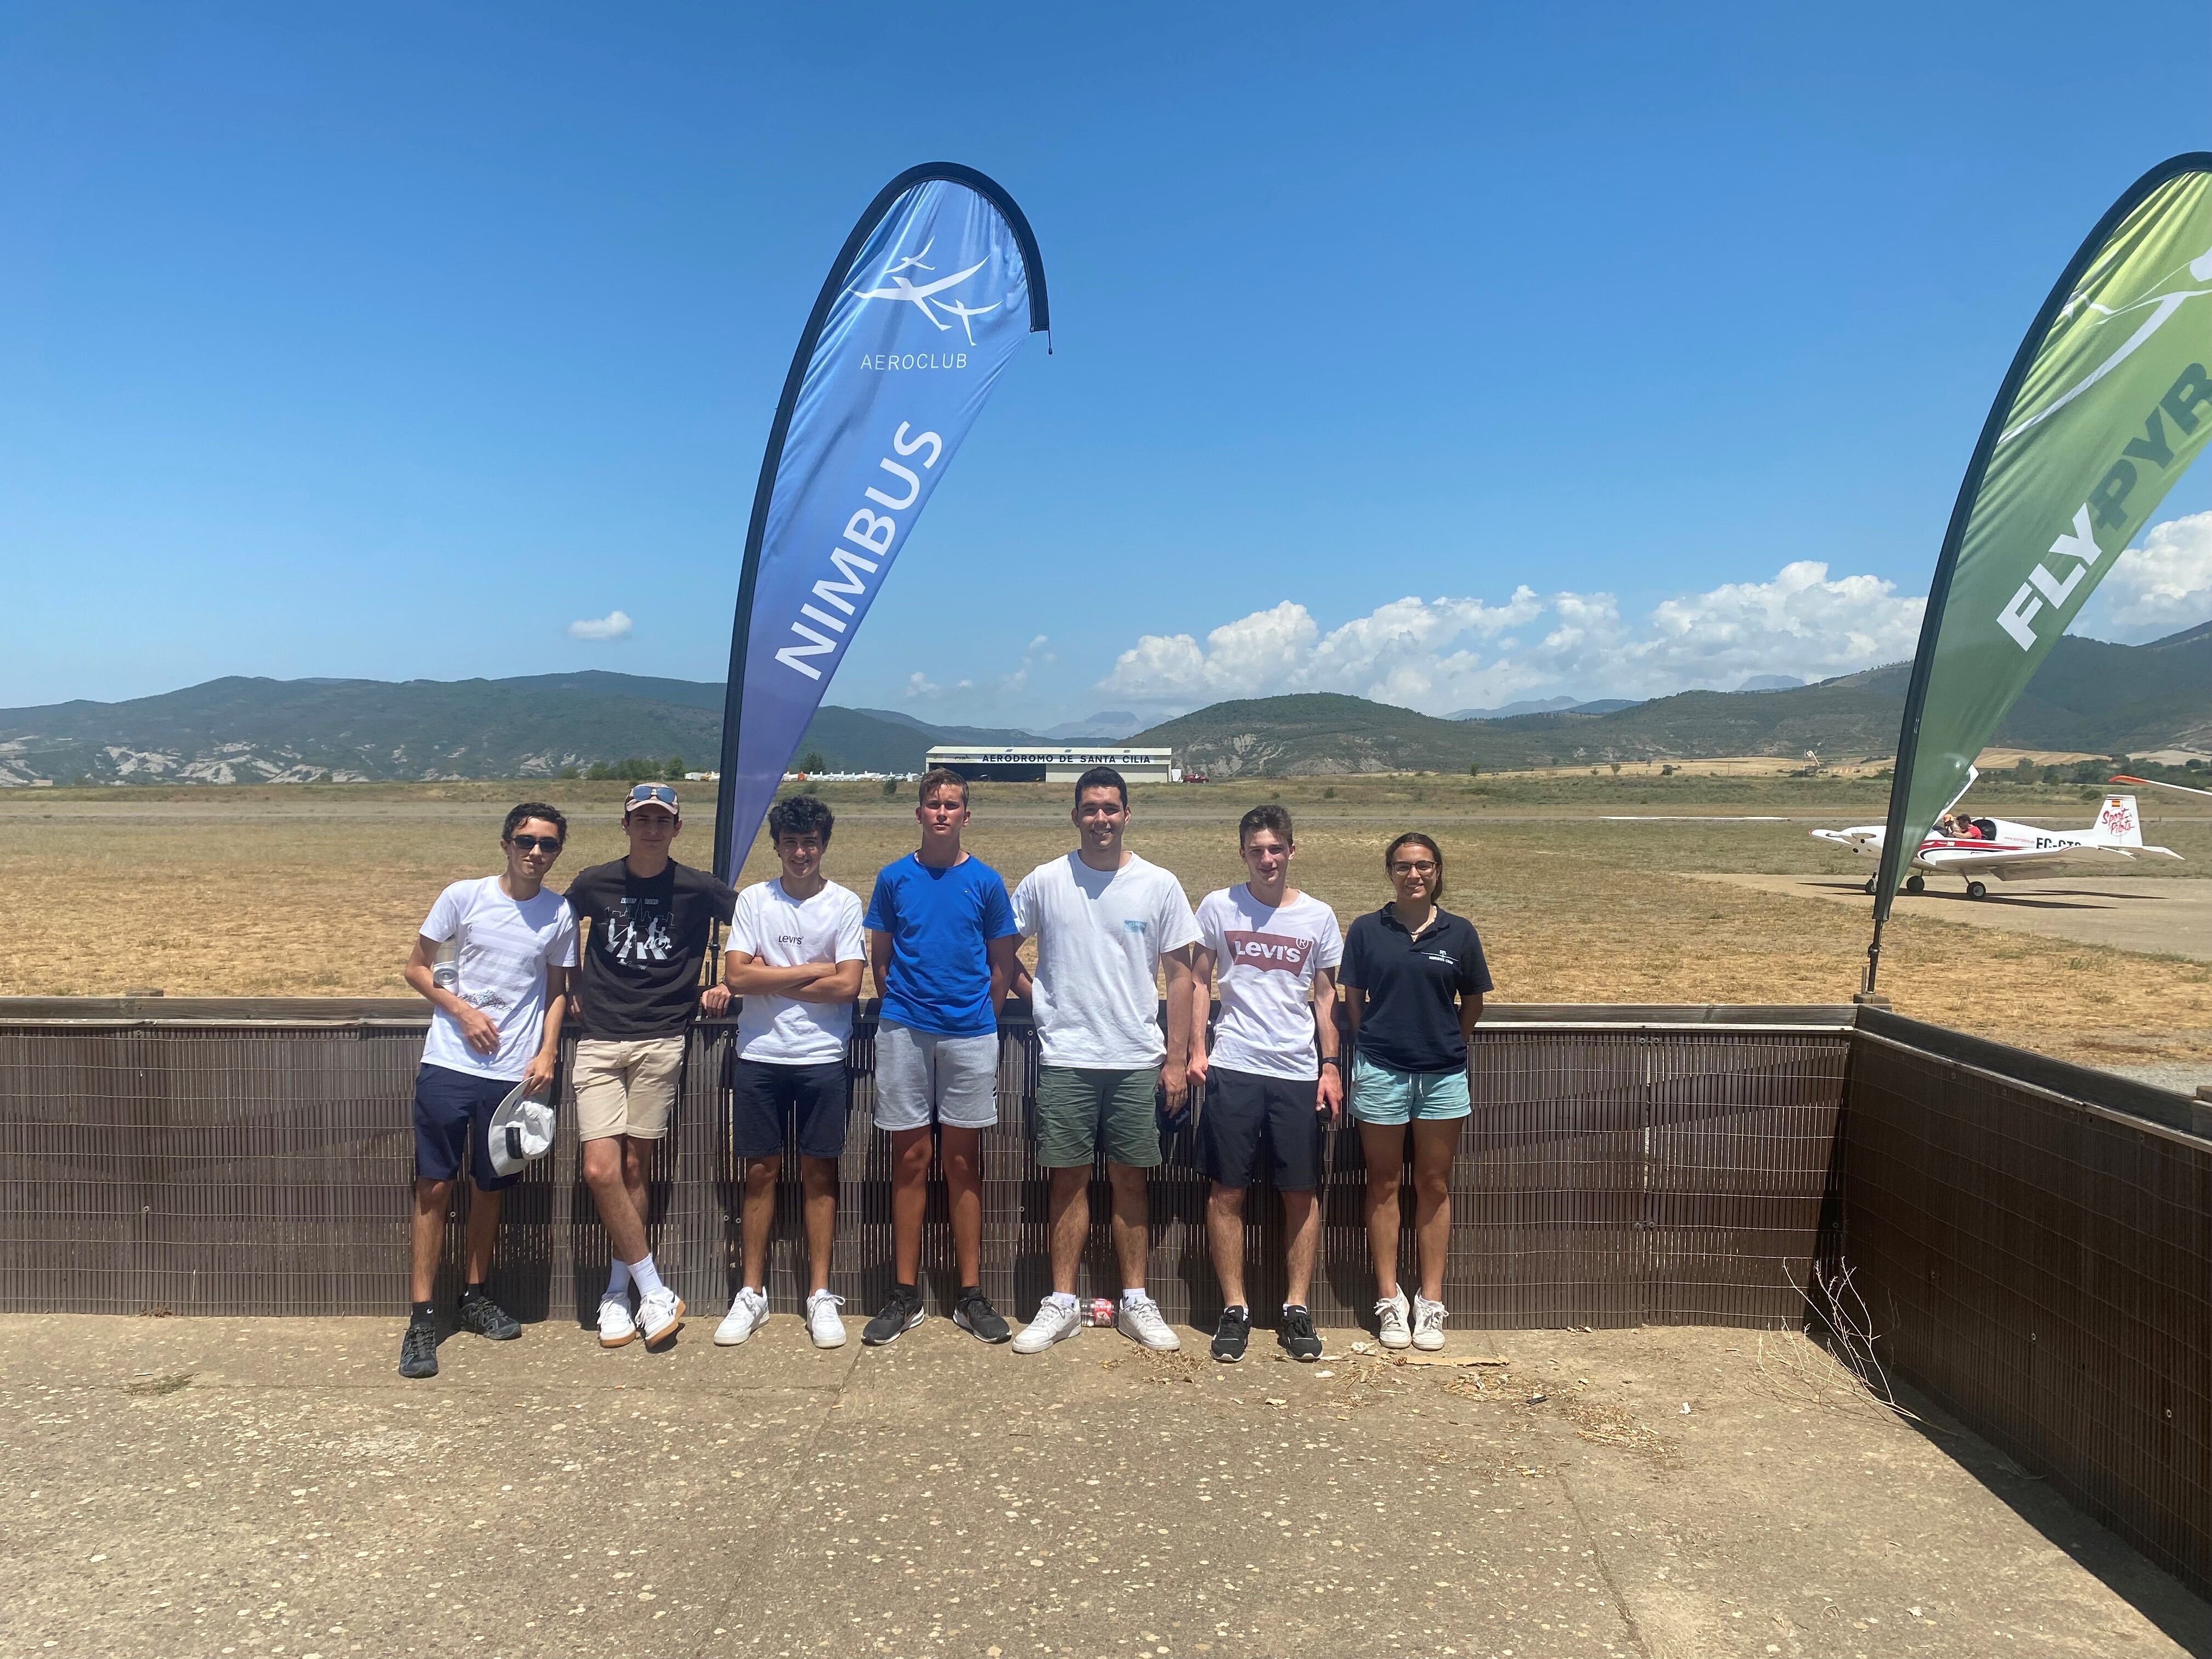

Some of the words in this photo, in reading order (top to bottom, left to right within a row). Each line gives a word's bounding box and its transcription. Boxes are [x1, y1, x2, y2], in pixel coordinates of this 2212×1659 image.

[860, 353, 967, 370] AEROCLUB
[774, 420, 943, 681] NIMBUS
[982, 754, 1054, 763] AERODROMO
[2102, 808, 2129, 826] Sport
